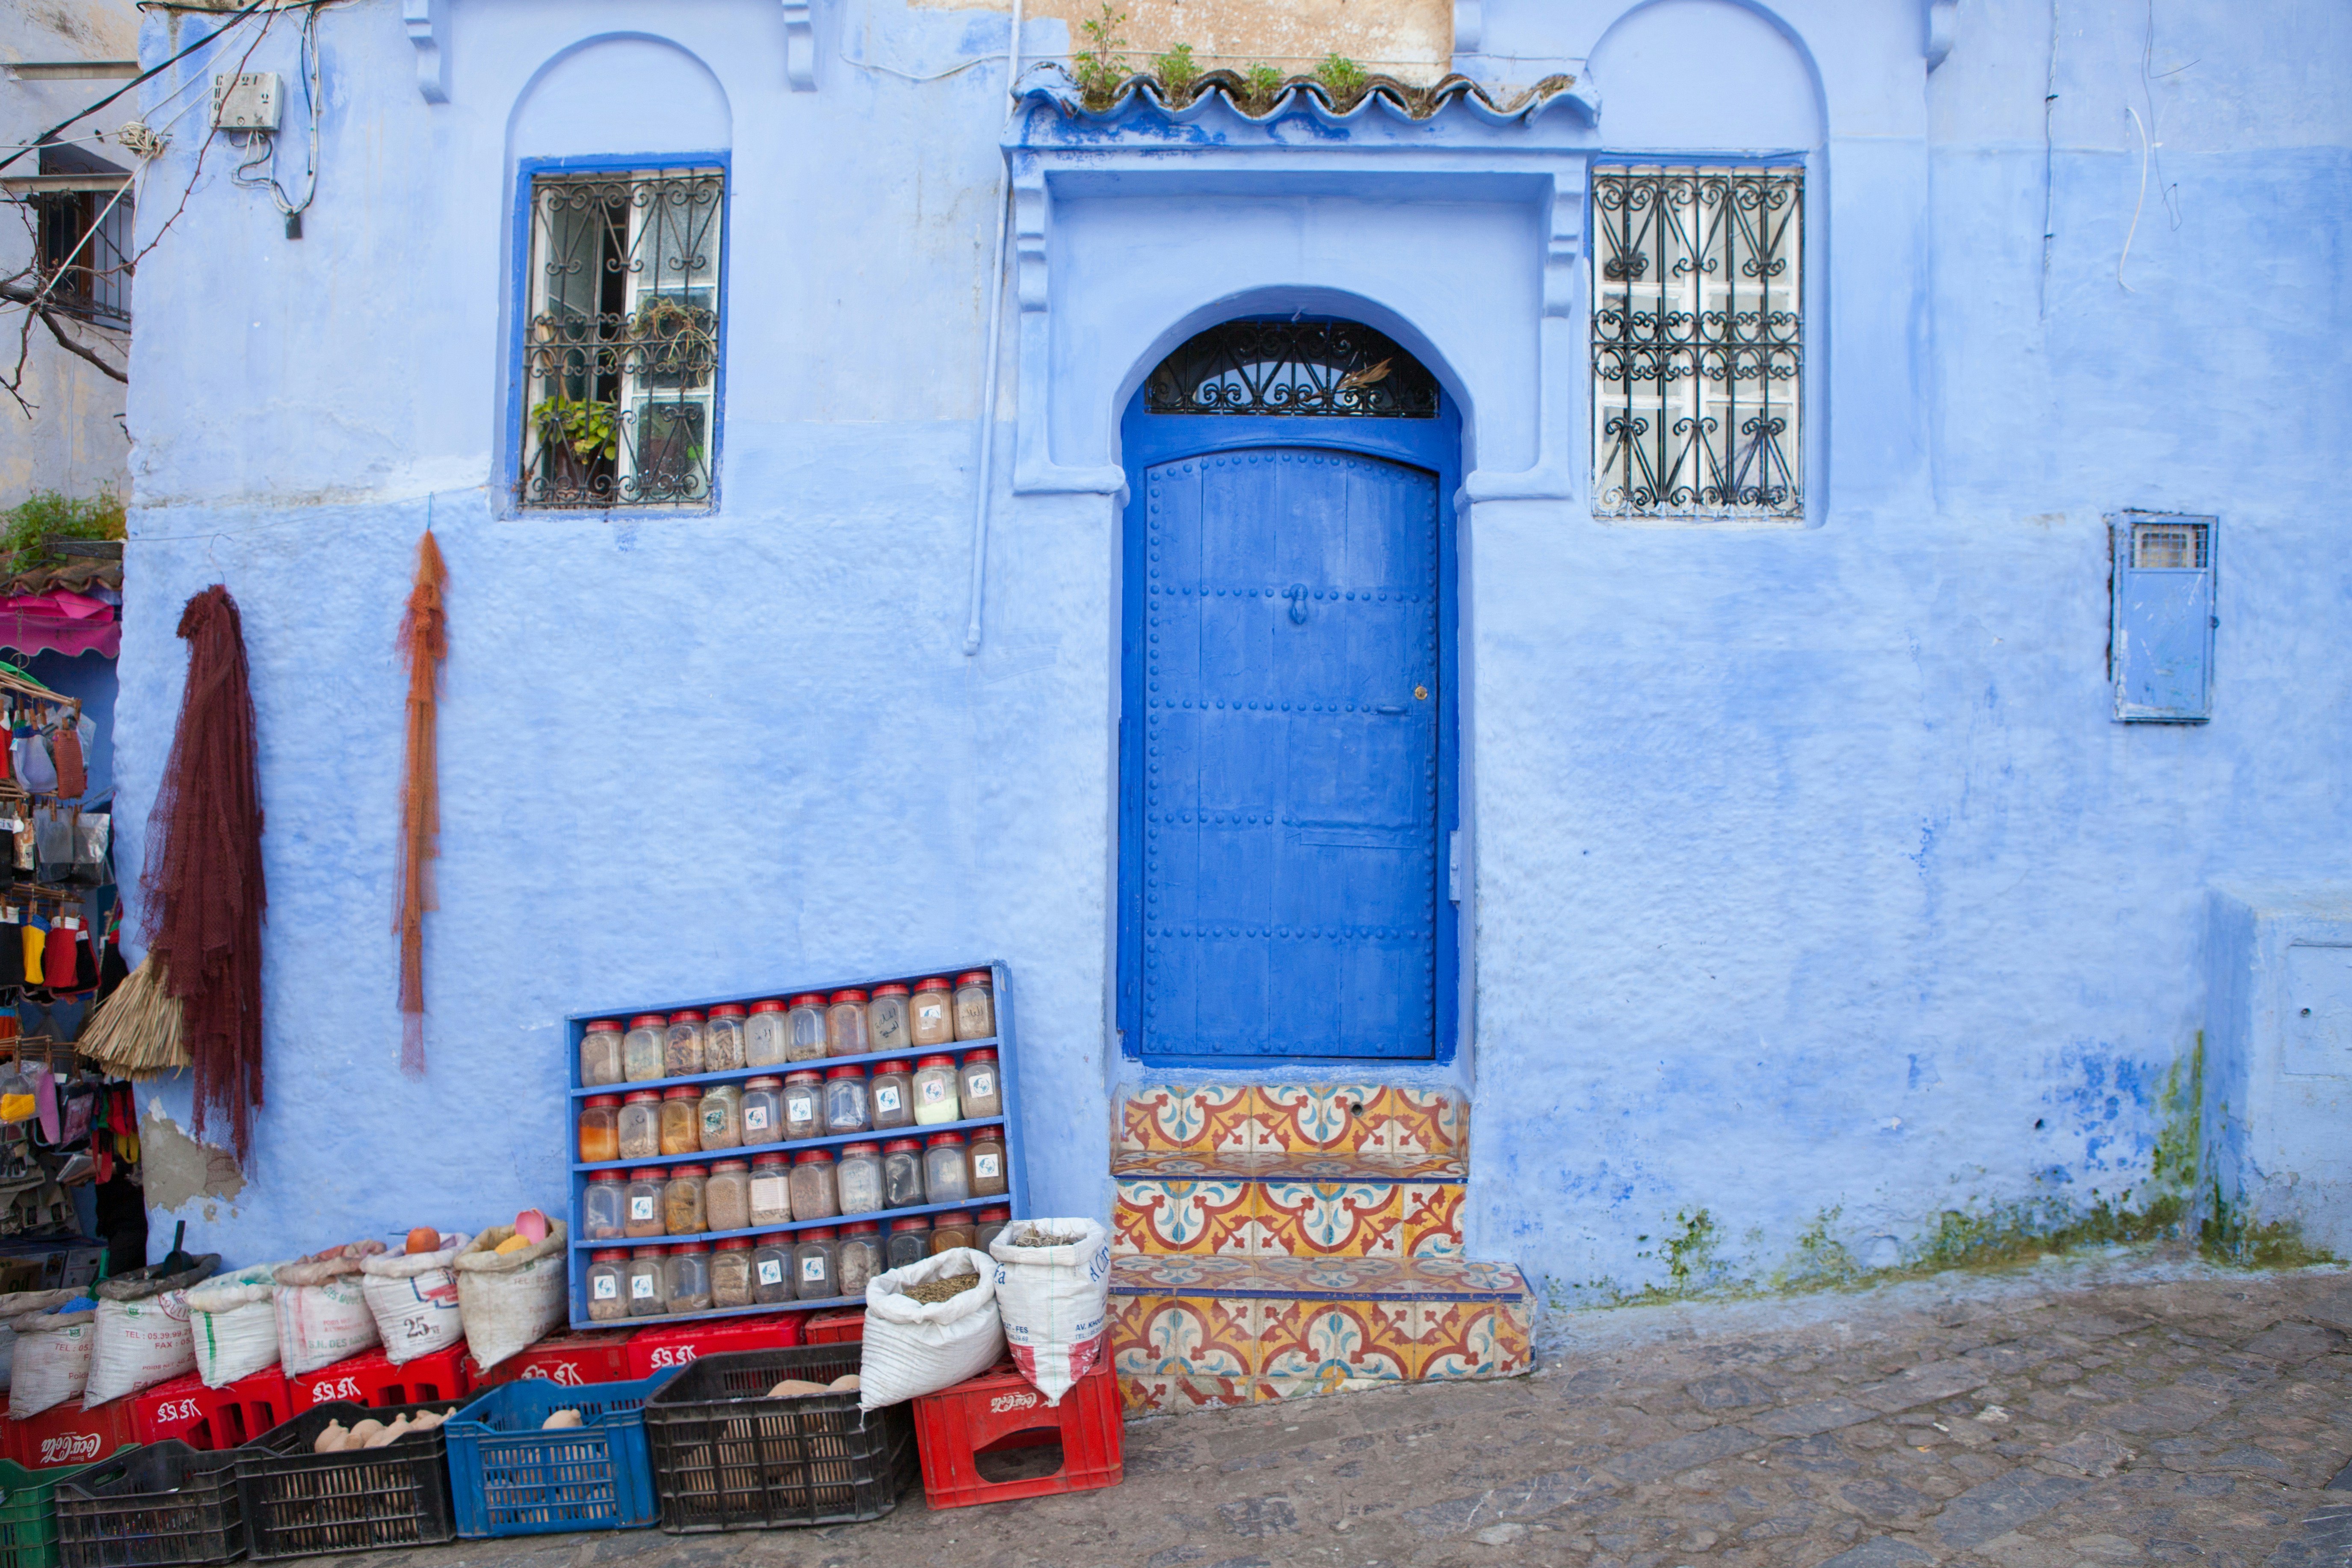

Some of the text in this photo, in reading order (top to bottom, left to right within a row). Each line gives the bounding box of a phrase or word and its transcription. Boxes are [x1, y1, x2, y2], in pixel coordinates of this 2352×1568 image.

[125, 1330, 141, 1339] TEL
[404, 1316, 430, 1338] 25
[55, 1343, 70, 1352] TEL
[329, 1338, 347, 1348] DES
[991, 1392, 1037, 1413] Coca-Cola
[40, 1433, 101, 1464] Coca-Cola
